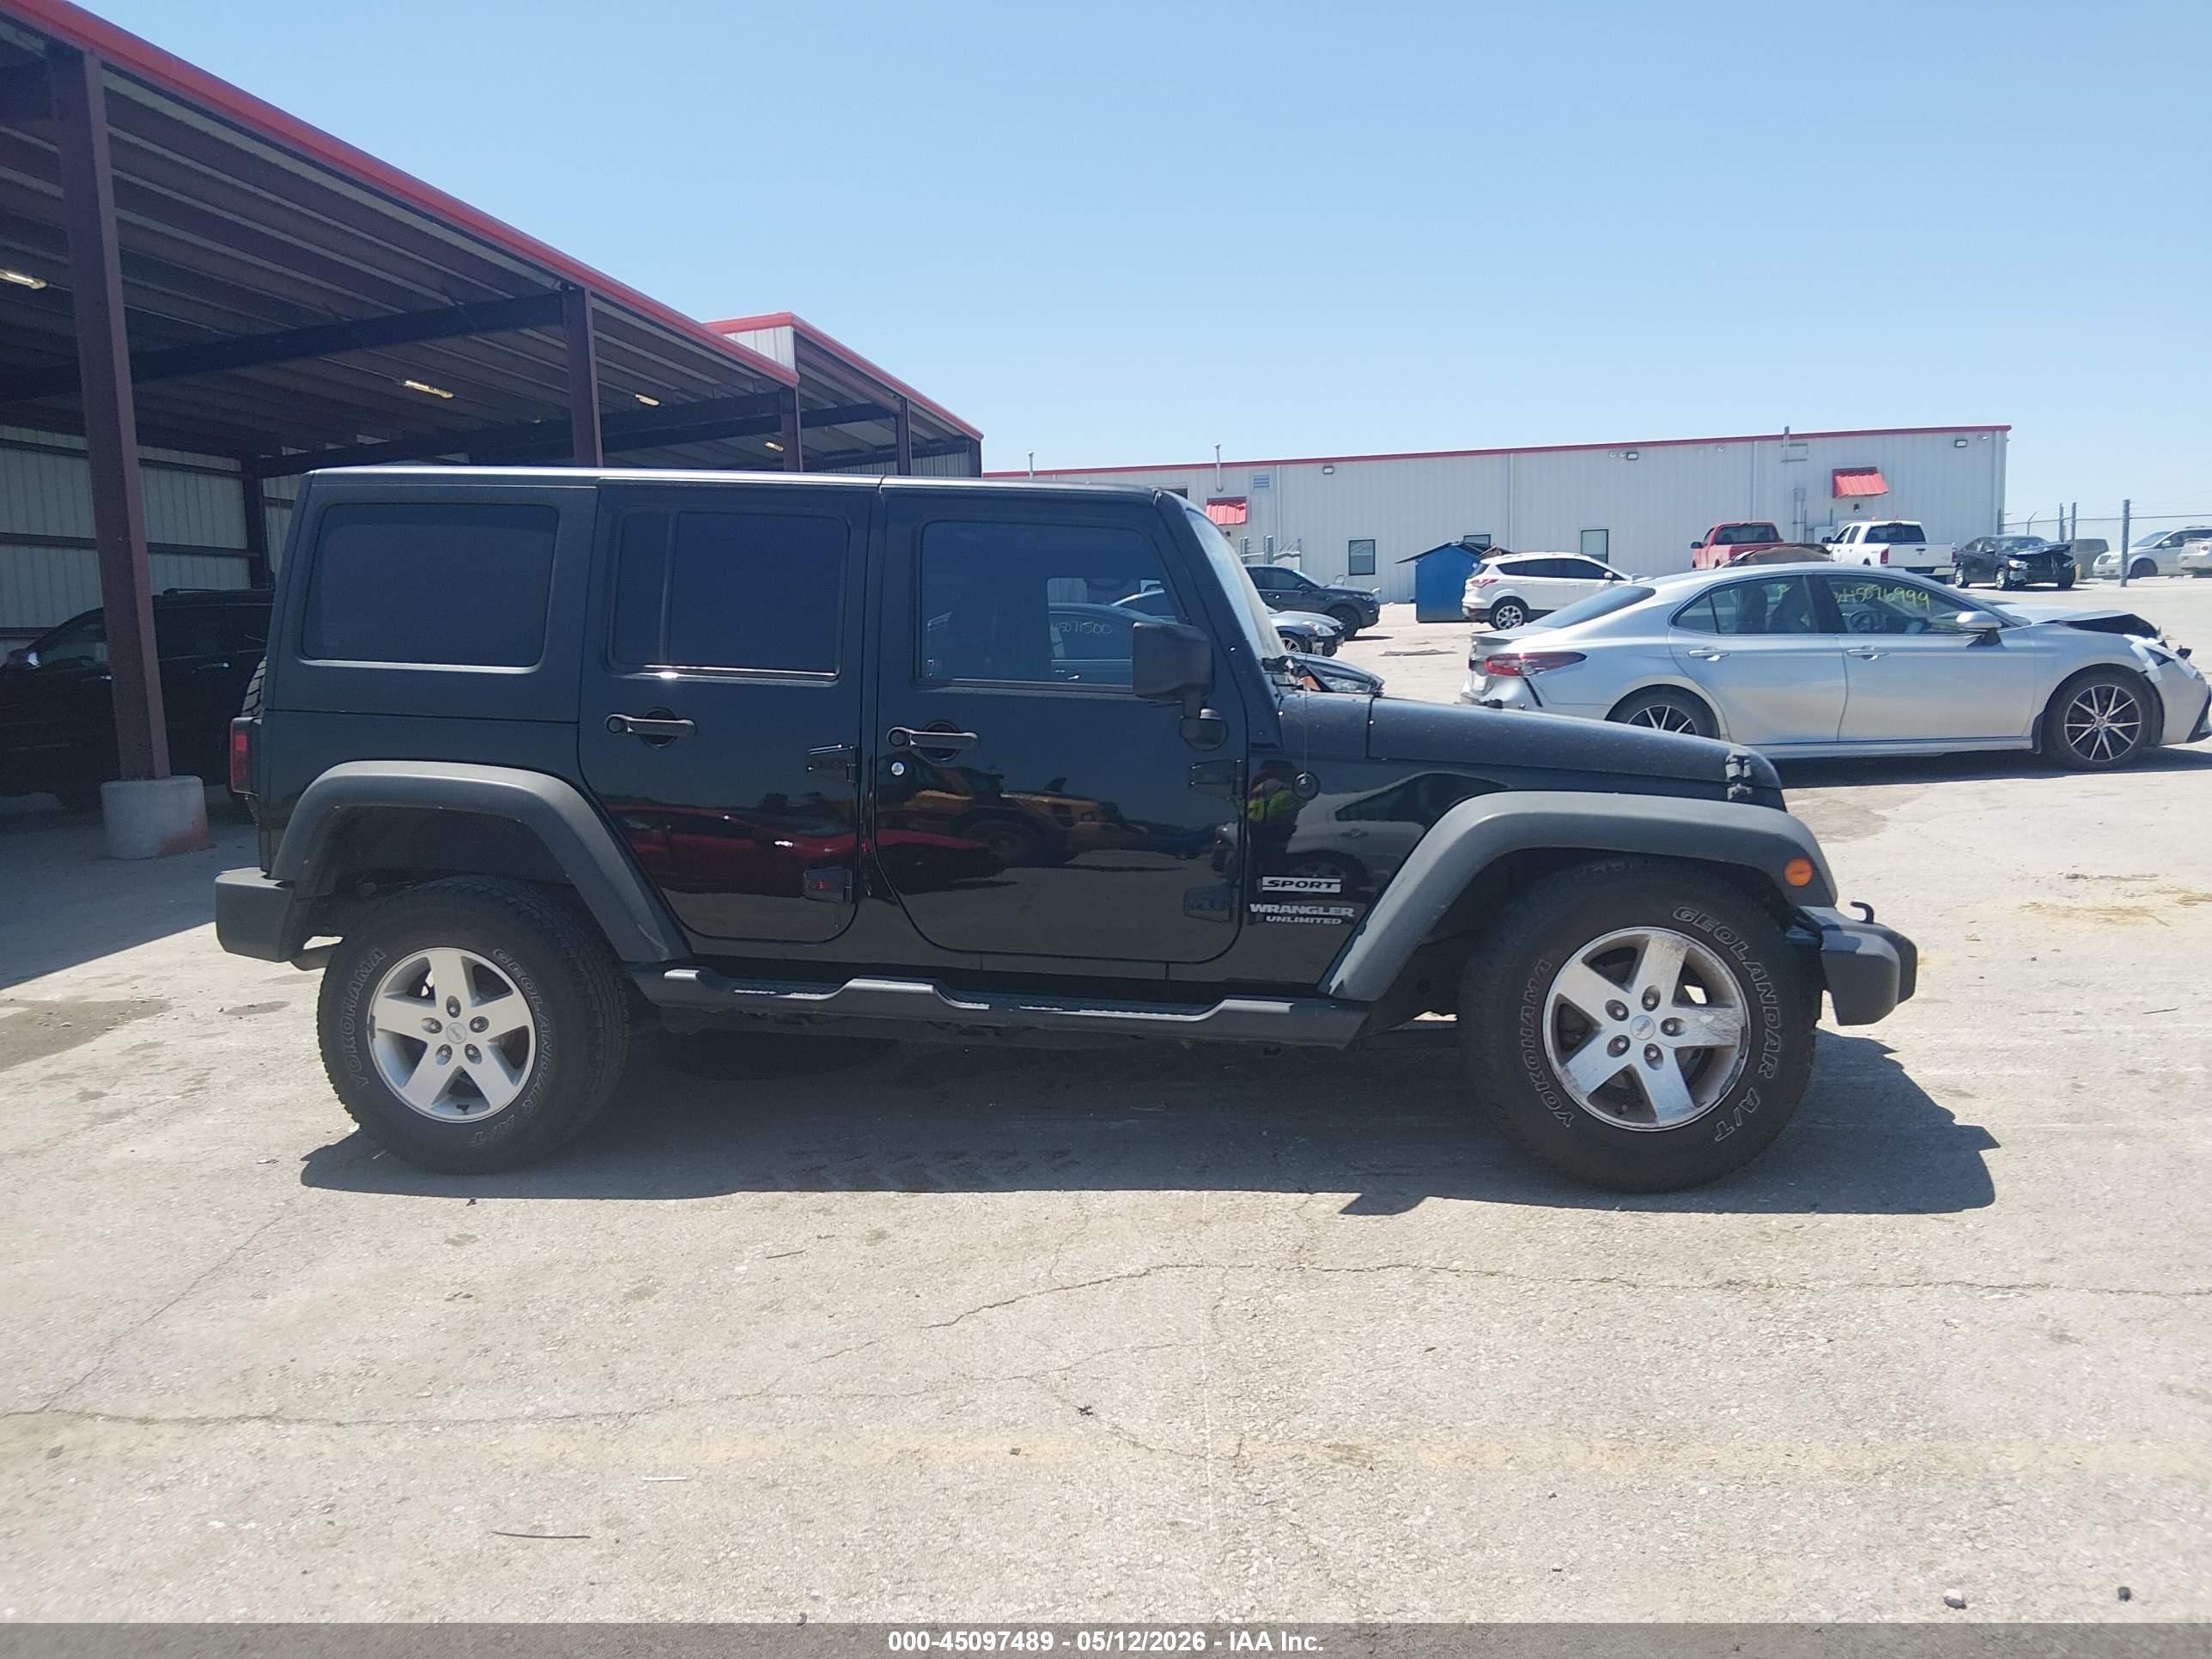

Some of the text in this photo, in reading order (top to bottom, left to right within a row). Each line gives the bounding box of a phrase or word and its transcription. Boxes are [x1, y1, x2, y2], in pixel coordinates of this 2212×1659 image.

[1263, 878, 1338, 890] SPORT
[1249, 902, 1355, 918] WRANGLER
[1266, 915, 1342, 925] UNLIMITED
[1672, 905, 1781, 1079] GEOLANDAR
[1519, 958, 1575, 1127] YOKOHAMA
